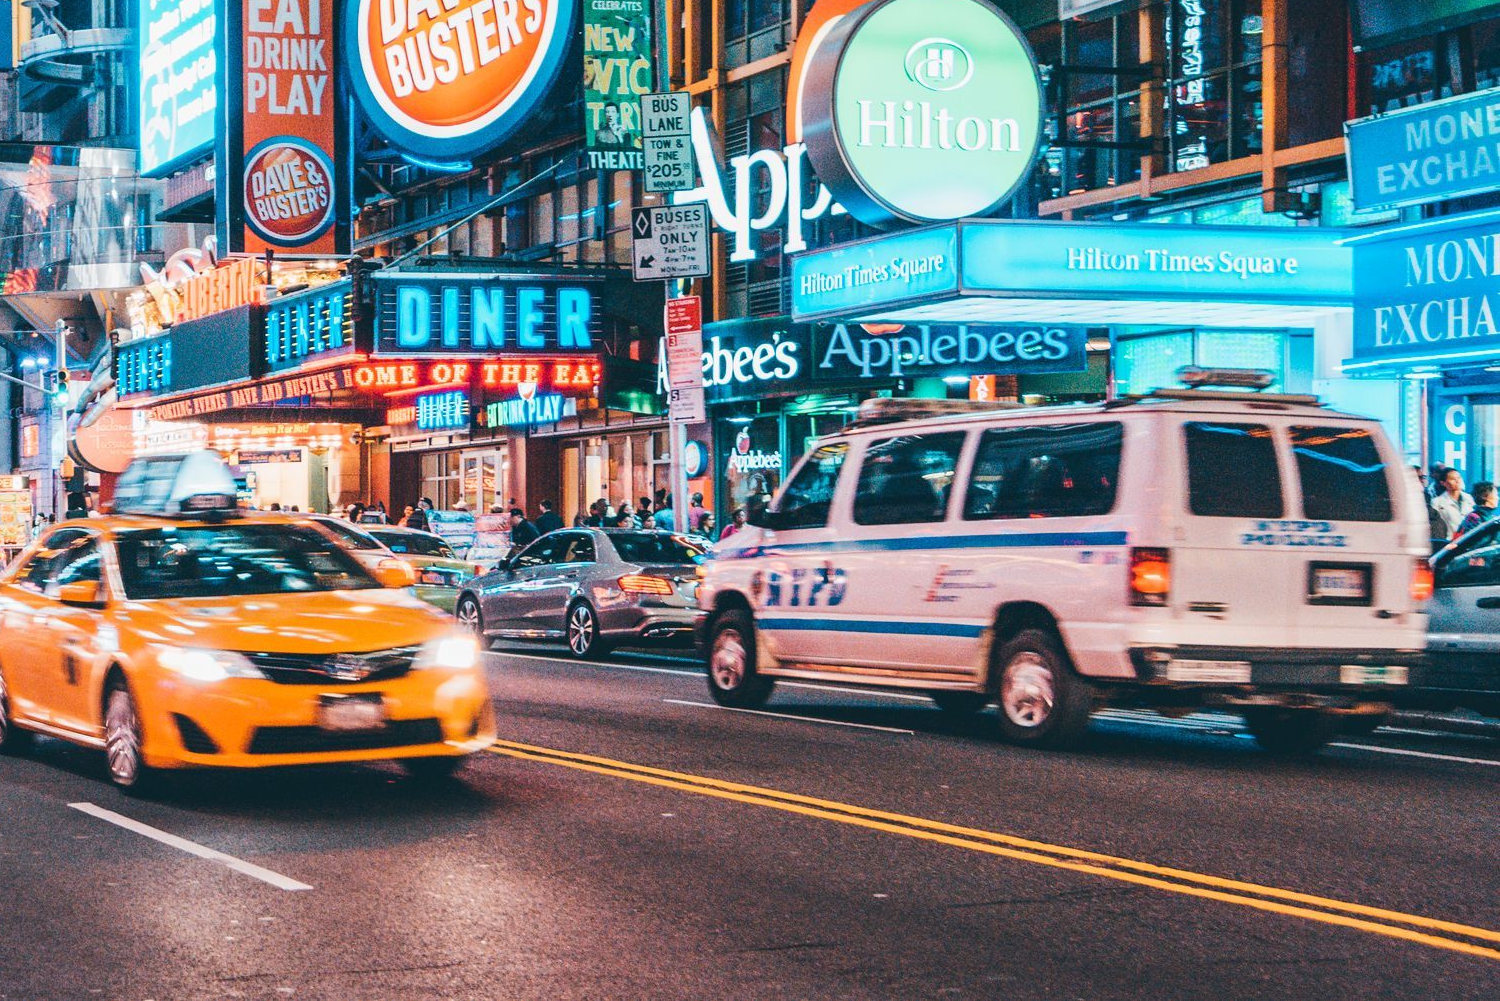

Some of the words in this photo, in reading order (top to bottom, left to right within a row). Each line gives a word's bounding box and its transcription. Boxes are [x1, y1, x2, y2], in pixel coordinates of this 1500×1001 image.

[591, 0, 643, 11] CELEBRATES
[247, 35, 328, 72] DRINK
[584, 23, 636, 52] NEW
[593, 58, 651, 95] VIC
[247, 72, 328, 116] PLAY
[652, 98, 679, 114] BUS
[649, 117, 684, 132] LANE
[855, 100, 1022, 153] Hilton
[588, 150, 644, 170] THEATE
[651, 139, 672, 150] TOW
[676, 139, 684, 149] &
[656, 151, 679, 162] FINE
[251, 161, 304, 198] DAVE
[304, 159, 323, 188] &
[653, 179, 686, 189] MINIMUM
[1376, 142, 1500, 195] EXCHA
[255, 184, 328, 223] BUSTER'S
[655, 209, 701, 225] BUSES
[659, 230, 699, 246] ONLY
[801, 269, 844, 297] Hilton
[845, 261, 889, 289] Times
[890, 251, 945, 283] Square
[1067, 248, 1140, 271] Hilton
[1145, 248, 1213, 273] Times
[400, 287, 592, 350] DINER
[1373, 293, 1500, 348] EXCHA
[819, 323, 1069, 377] Applebee's
[656, 333, 799, 404] Aebee's
[150, 401, 193, 421] SPORTING
[194, 393, 227, 414] EVENTS
[233, 386, 259, 406] DAVE
[261, 381, 283, 401] AND
[286, 373, 339, 397] BUSTER'S
[432, 364, 468, 384] OF
[484, 364, 540, 385] THE
[498, 398, 525, 426] DRINK
[528, 394, 562, 423] PLAY
[729, 447, 782, 473] Applebee's
